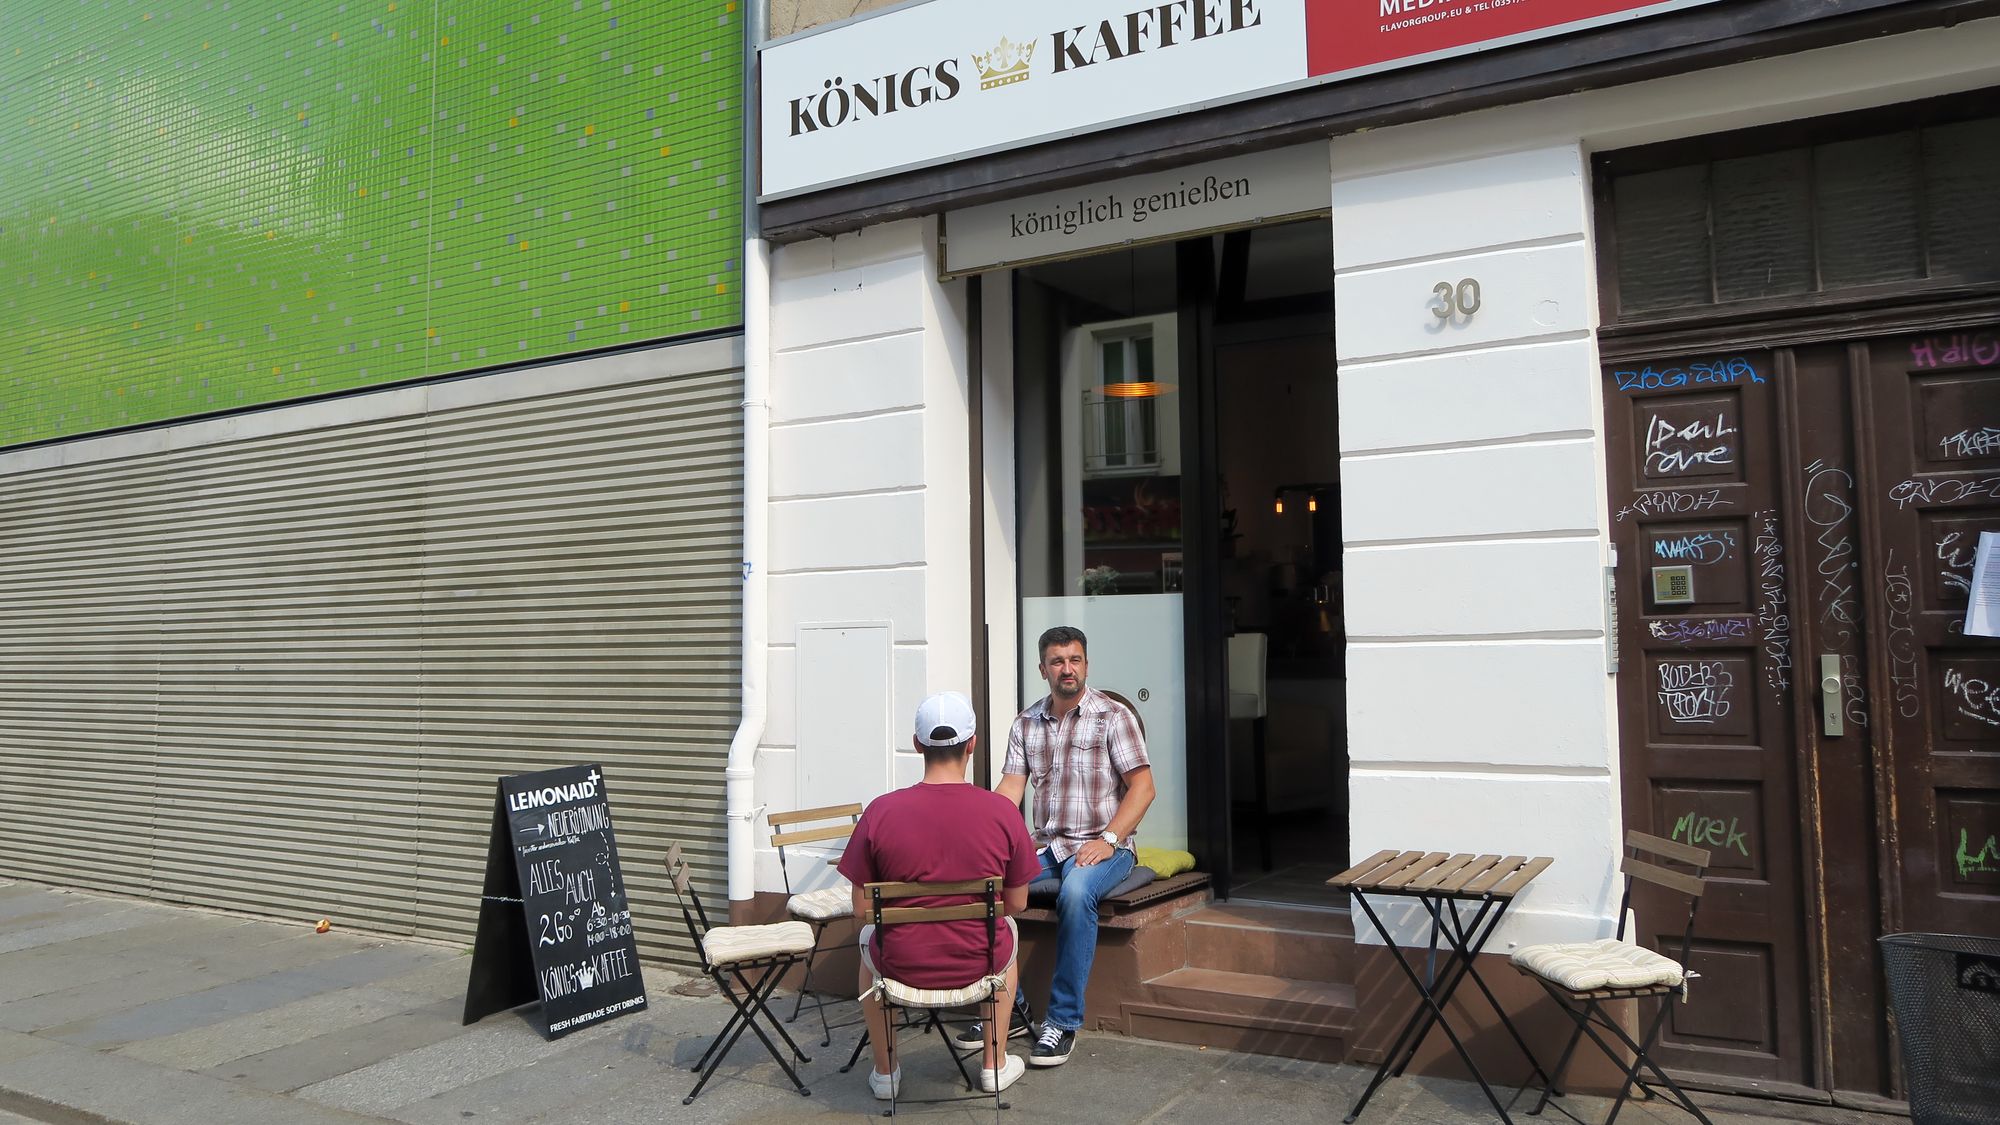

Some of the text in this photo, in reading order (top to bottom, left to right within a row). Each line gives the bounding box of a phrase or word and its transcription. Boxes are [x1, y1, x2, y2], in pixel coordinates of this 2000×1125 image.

[1380, 8, 1463, 33] FLAVORGROUP.EU
[1464, 6, 1472, 14] &
[1473, 3, 1490, 13] TEL
[789, 0, 1262, 137] KÖNIGS KAFFEE
[1010, 176, 1251, 238] königlich genießen
[1431, 277, 1481, 319] 30
[530, 859, 565, 897] ALLES
[566, 868, 597, 905] AUCH
[591, 901, 606, 919] Ab
[540, 948, 633, 1003] KÖNIGS KAFFEE
[550, 995, 645, 1033] FRESH FAIRTRADE SOFT DRINKS
